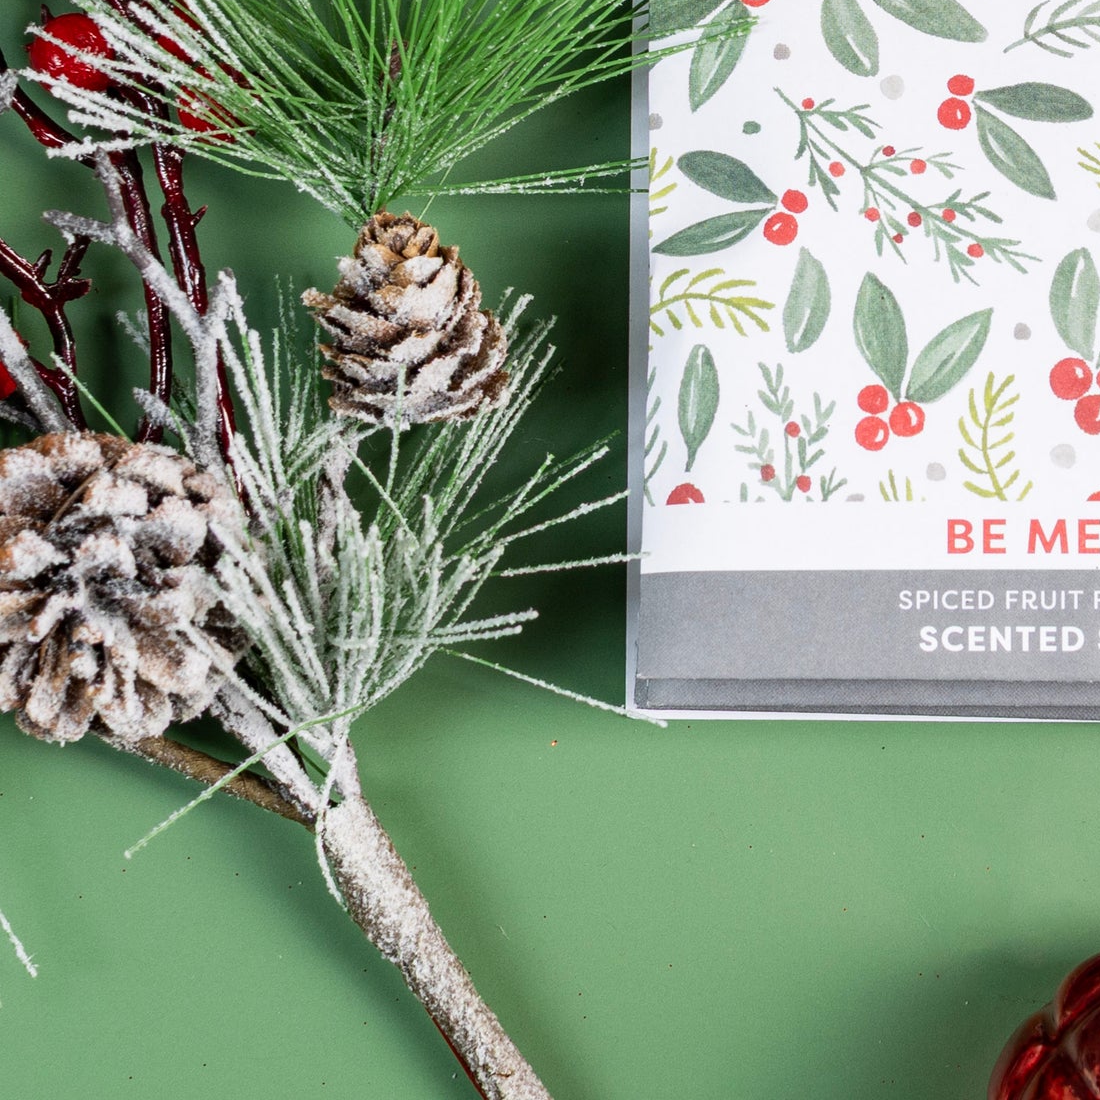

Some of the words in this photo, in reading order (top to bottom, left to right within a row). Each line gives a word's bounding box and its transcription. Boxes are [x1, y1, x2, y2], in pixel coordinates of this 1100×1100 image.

[947, 518, 1008, 555] BE
[898, 589, 995, 611] SPICED
[1004, 589, 1085, 611] FRUIT
[918, 625, 1085, 653] SCENTED
